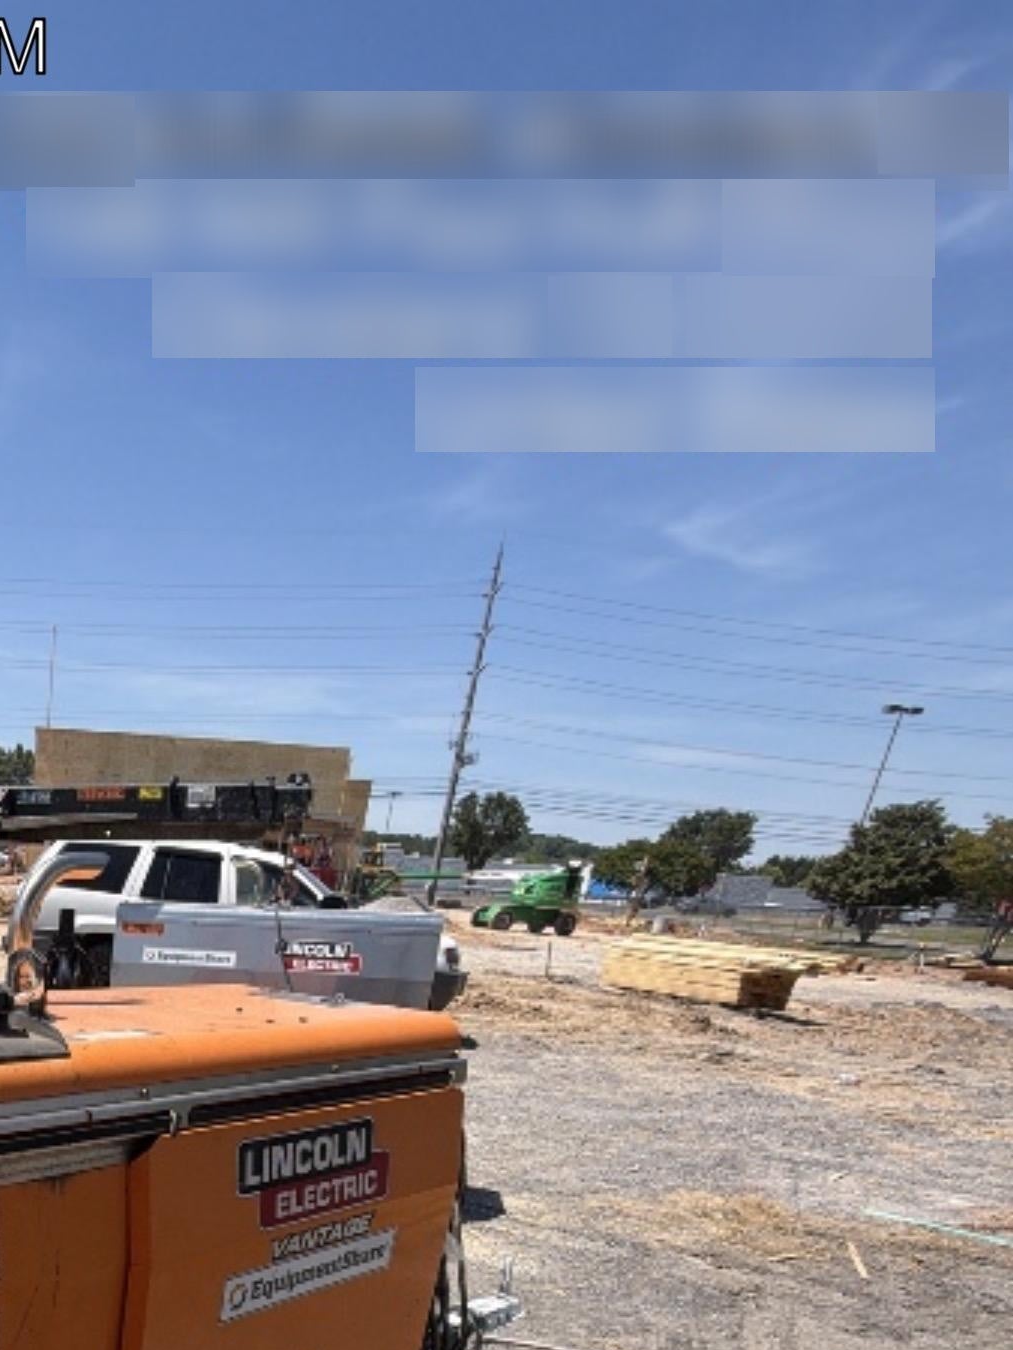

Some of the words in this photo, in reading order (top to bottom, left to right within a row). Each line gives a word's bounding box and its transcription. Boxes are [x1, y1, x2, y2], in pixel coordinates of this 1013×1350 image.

[244, 1127, 366, 1187] LINCOLN
[275, 1169, 378, 1219] ELECTRIC
[272, 1213, 374, 1260] VANTAGE
[250, 1245, 386, 1300] EquipmentShare
